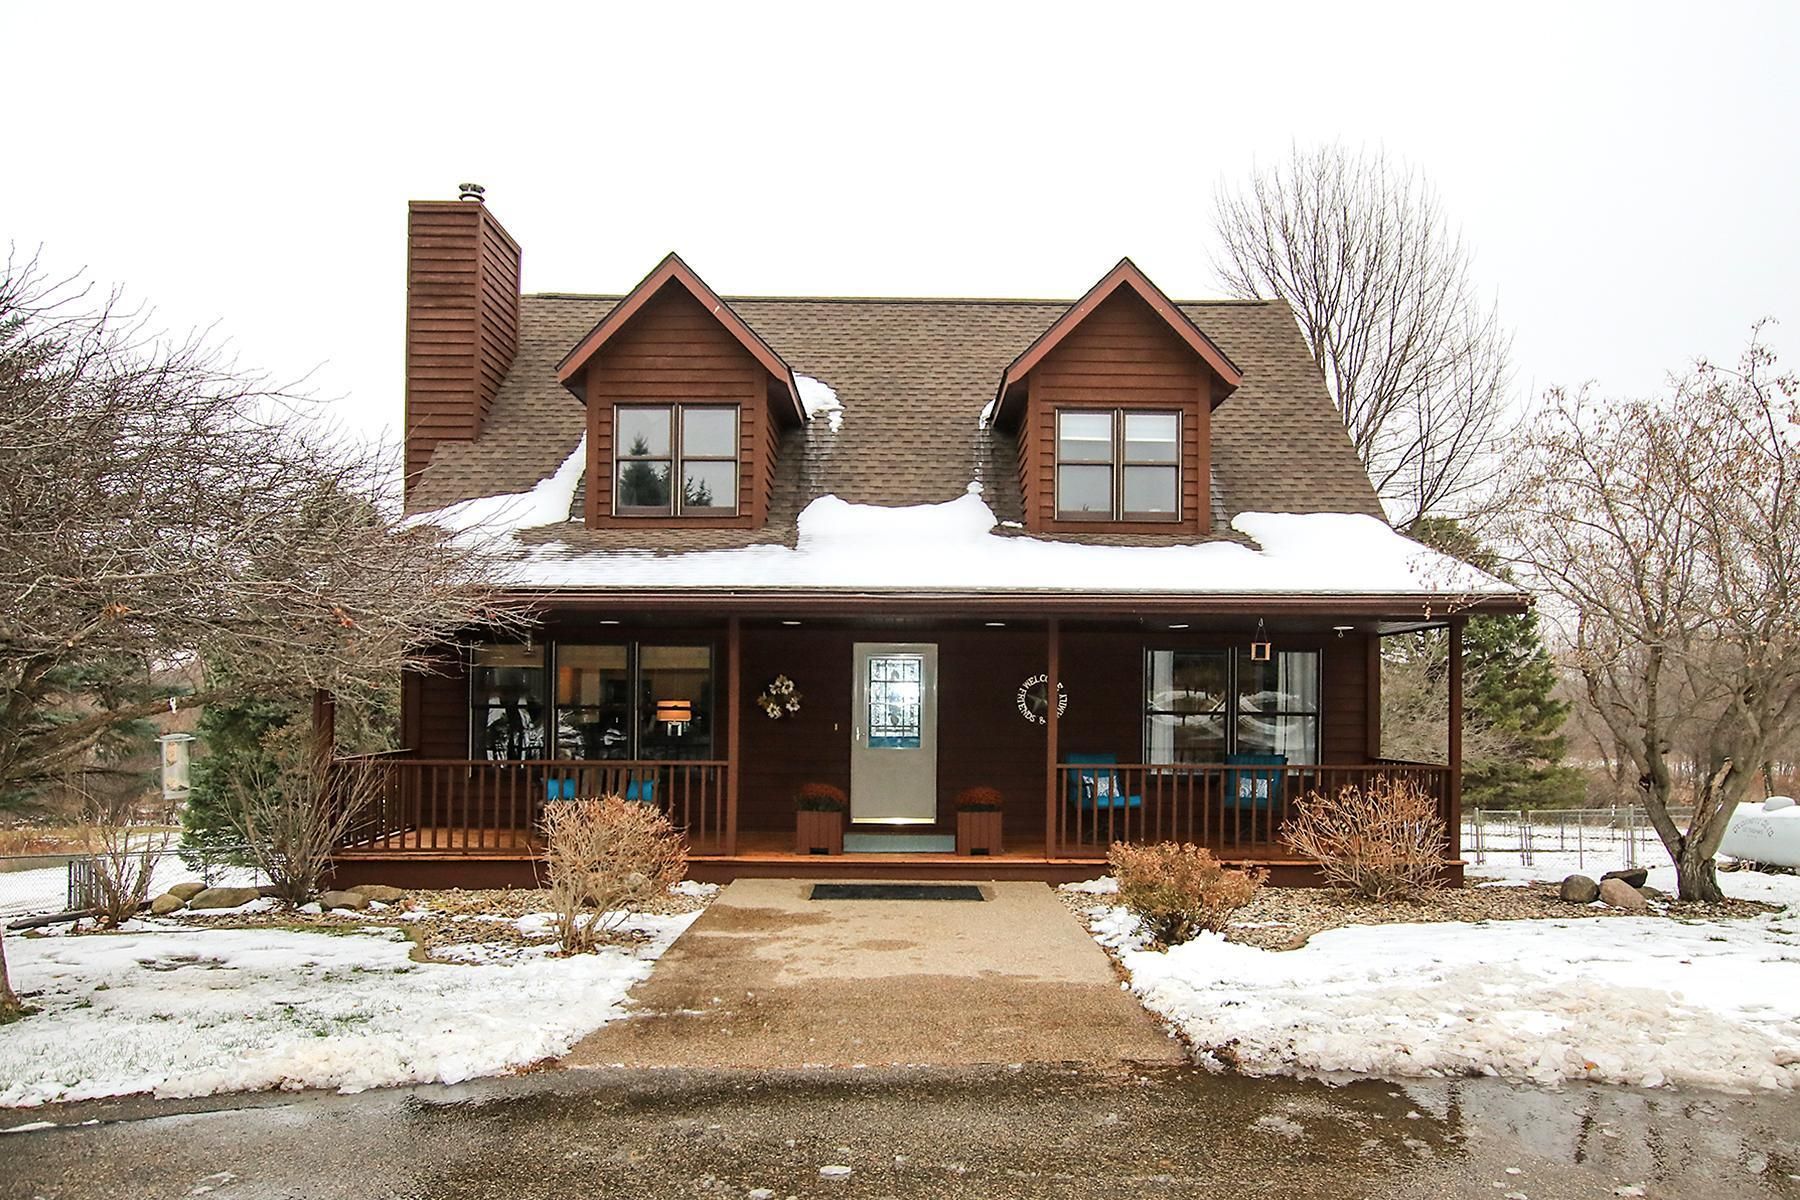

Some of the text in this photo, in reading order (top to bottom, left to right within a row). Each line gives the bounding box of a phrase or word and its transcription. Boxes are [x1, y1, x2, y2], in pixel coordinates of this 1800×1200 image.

[1022, 674, 1064, 691] WELCE
[1017, 687, 1068, 725] FRIENDS & AMILY
